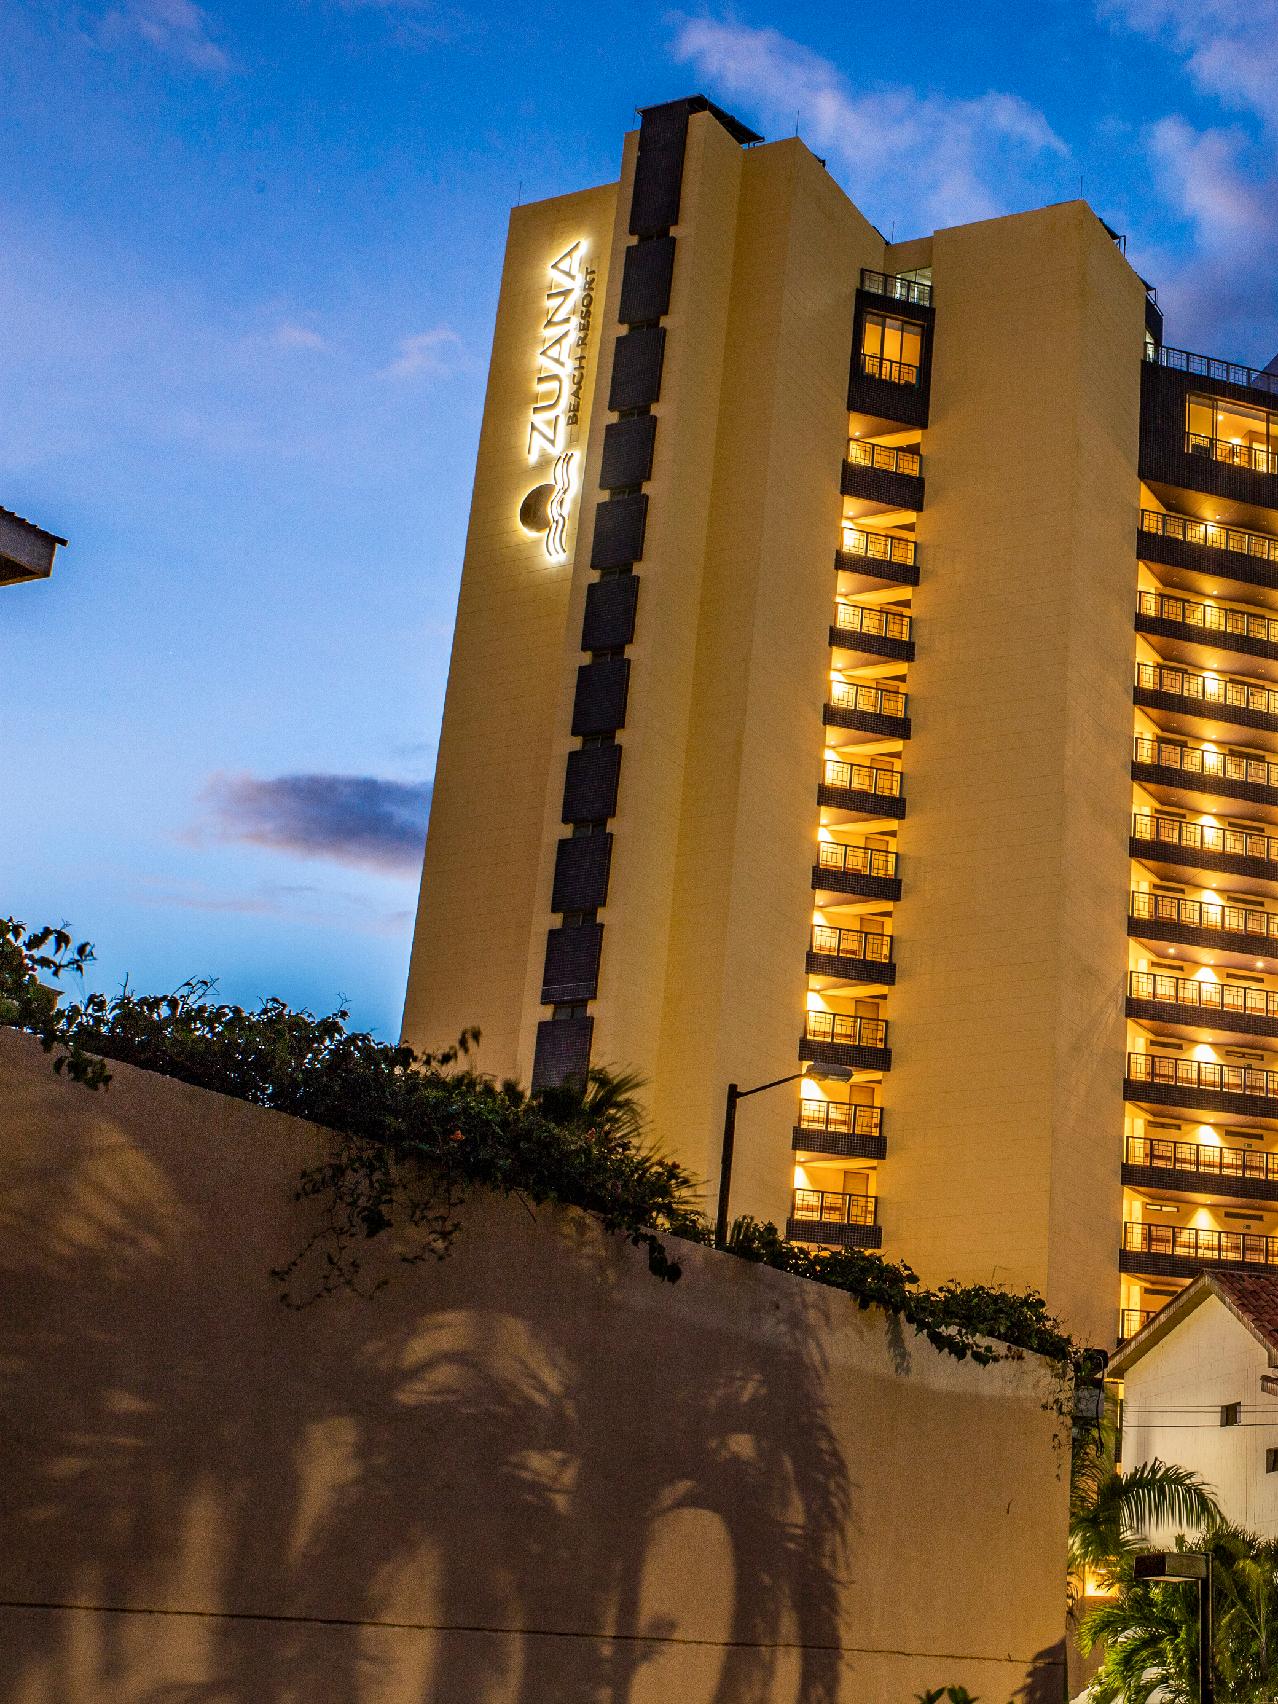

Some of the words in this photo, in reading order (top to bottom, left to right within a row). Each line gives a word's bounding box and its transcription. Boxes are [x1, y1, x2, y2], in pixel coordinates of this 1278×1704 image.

[528, 240, 583, 457] ZUANA
[566, 355, 586, 426] BEACH
[577, 266, 597, 348] RESORT
